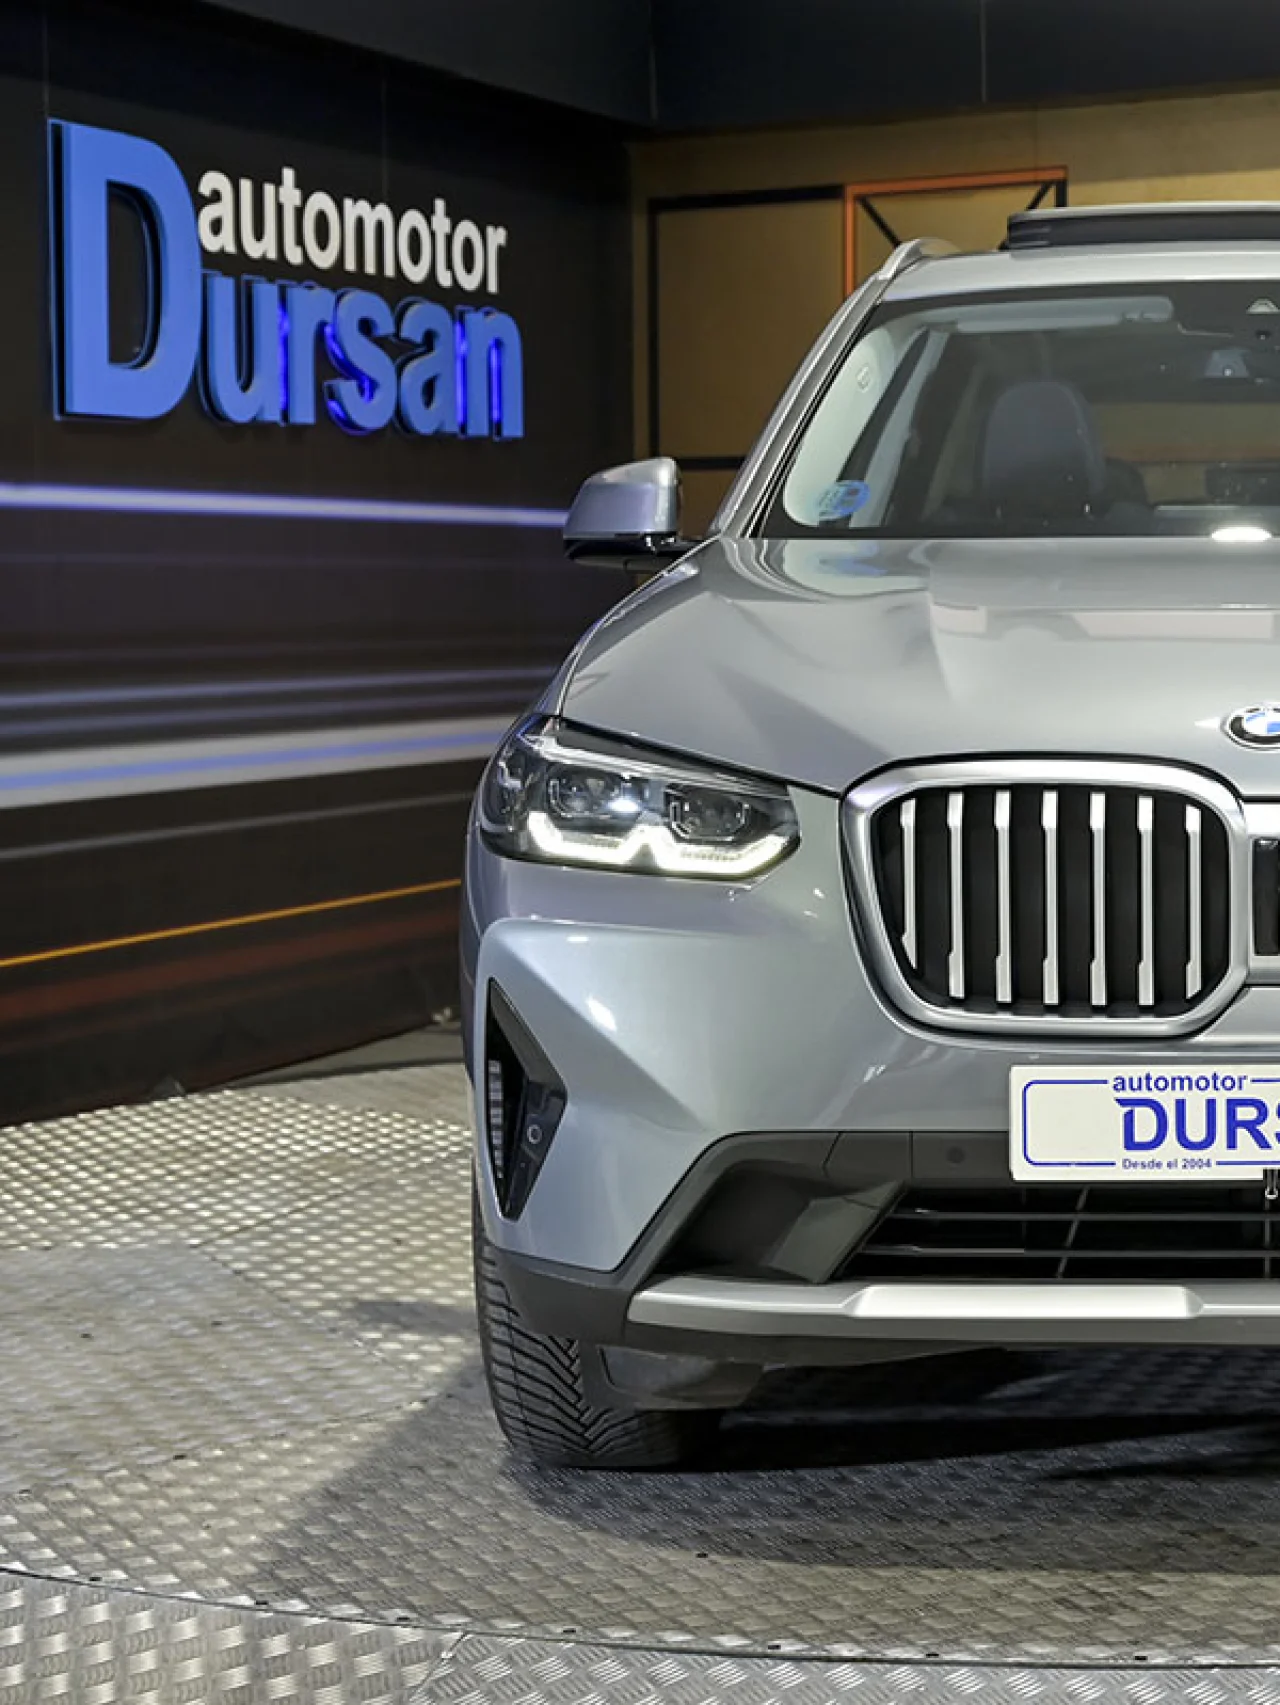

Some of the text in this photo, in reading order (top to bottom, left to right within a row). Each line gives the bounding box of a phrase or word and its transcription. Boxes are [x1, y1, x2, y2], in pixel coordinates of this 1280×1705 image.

[199, 167, 507, 294] automotor
[47, 117, 524, 438] Dursan
[1112, 1071, 1247, 1091] automotor
[1122, 1158, 1212, 1169] Desde el 2004
